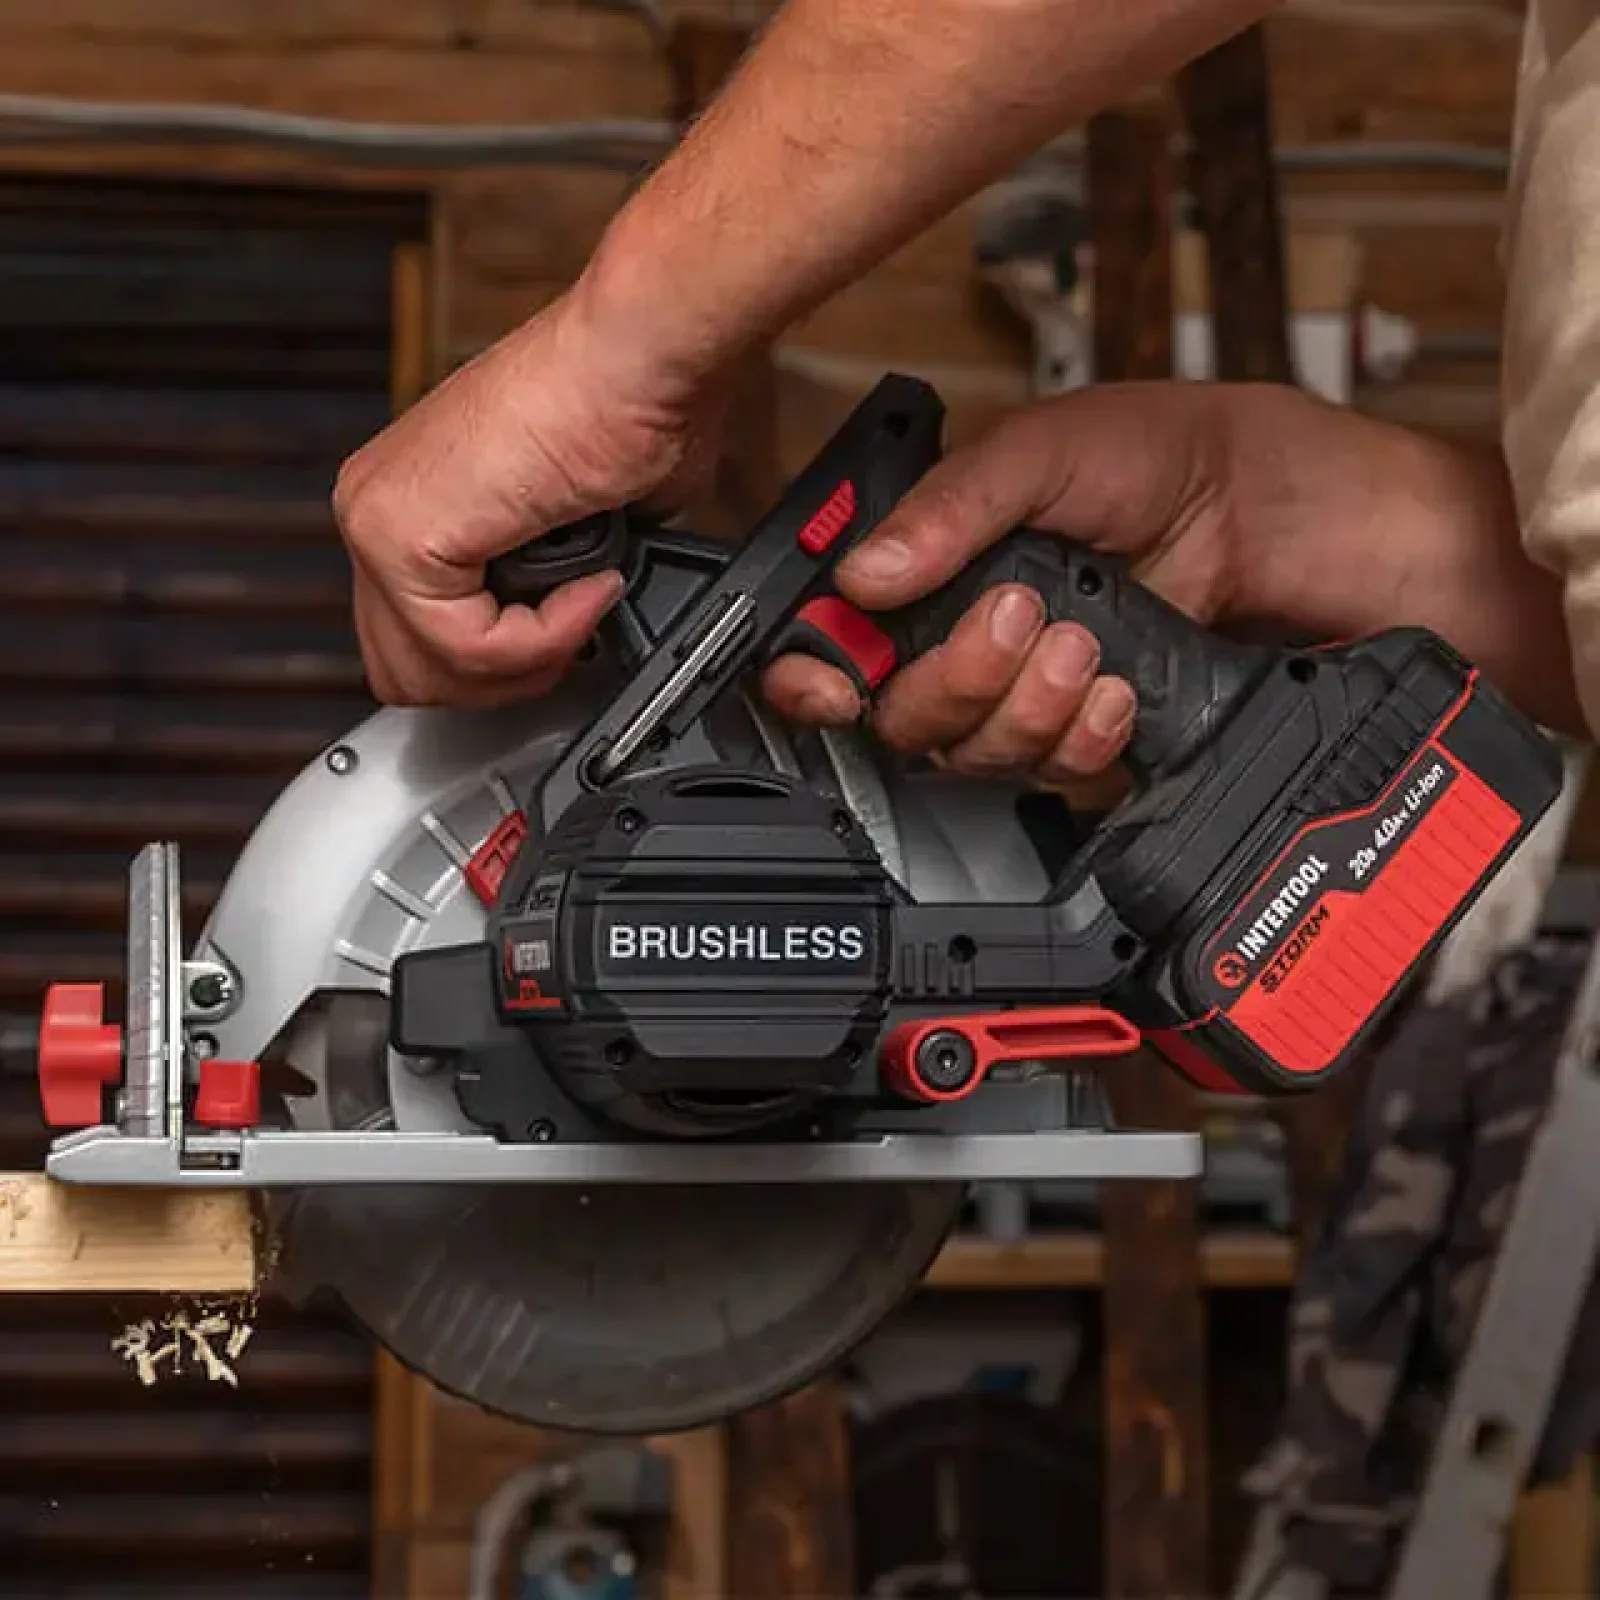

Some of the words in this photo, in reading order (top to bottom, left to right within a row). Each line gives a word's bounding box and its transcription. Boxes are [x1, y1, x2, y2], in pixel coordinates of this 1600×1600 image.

[609, 925, 863, 960] BRUSHLESS
[1237, 855, 1329, 960] INTERTOOL
[1259, 904, 1330, 994] STORM
